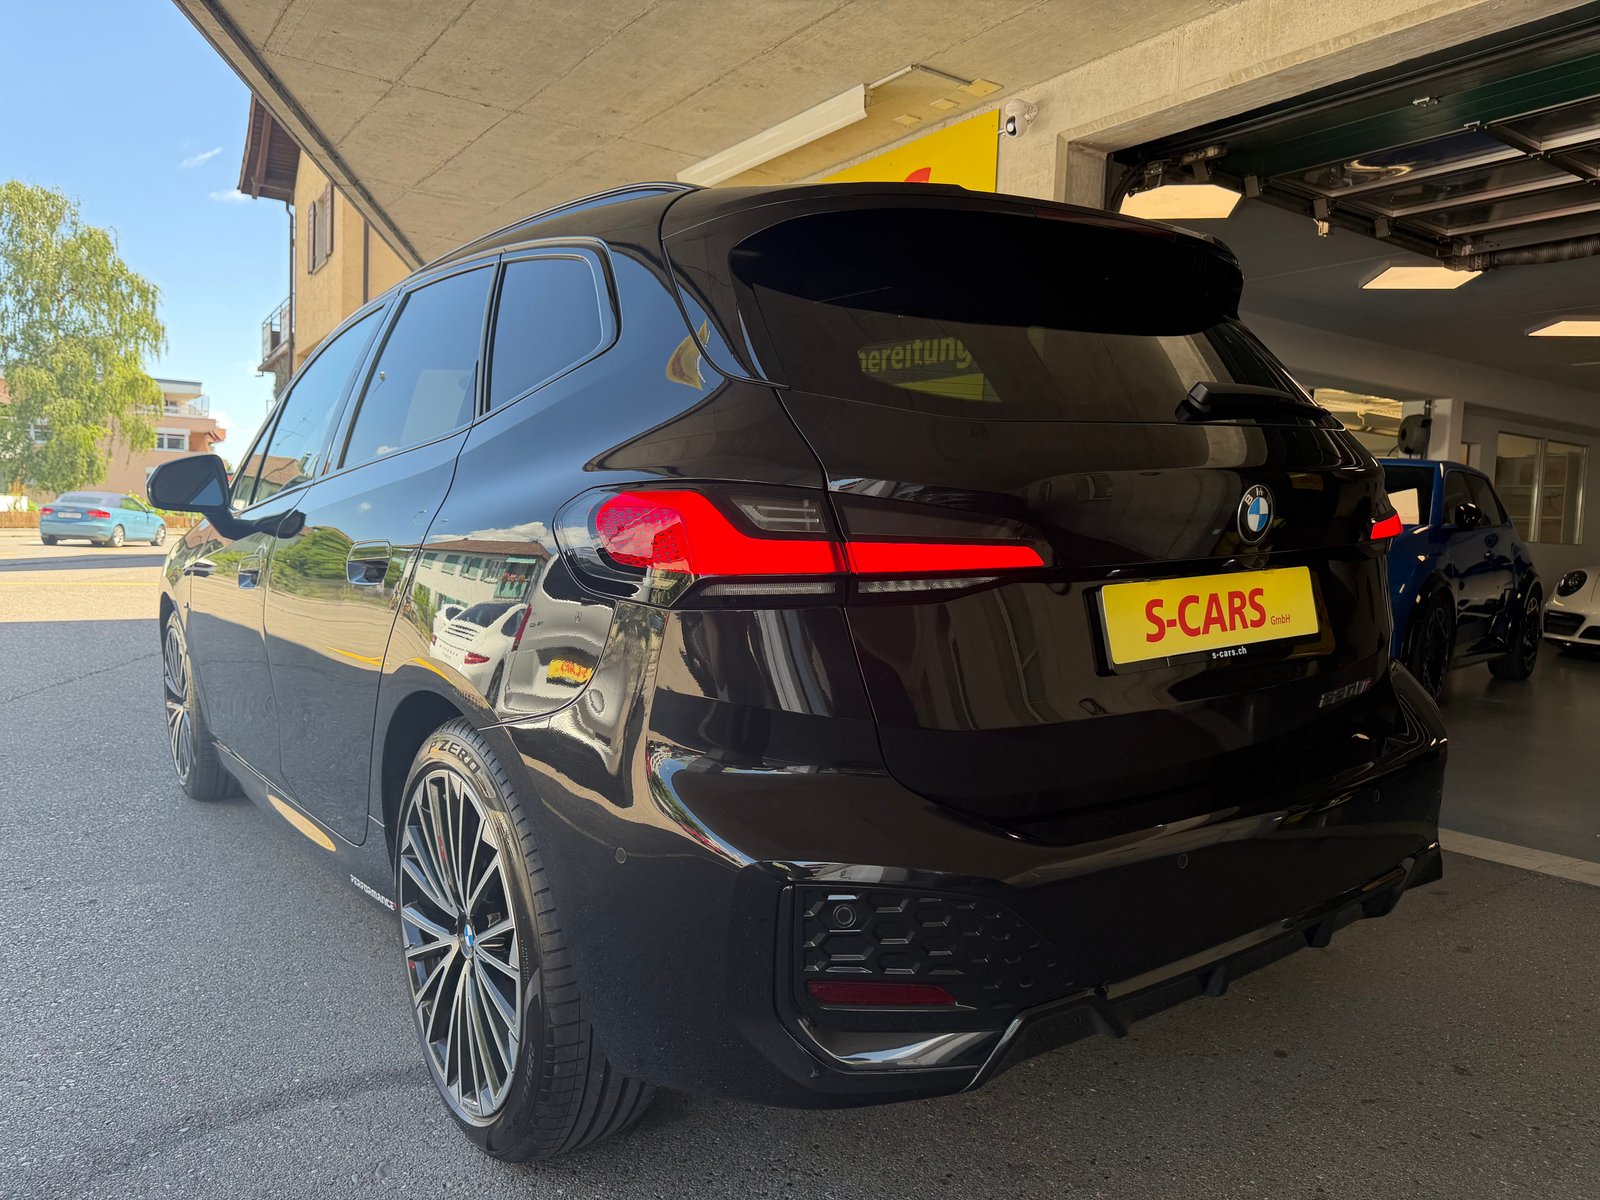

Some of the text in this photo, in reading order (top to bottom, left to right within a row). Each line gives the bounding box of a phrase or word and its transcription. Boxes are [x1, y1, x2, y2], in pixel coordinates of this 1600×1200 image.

[1145, 588, 1291, 642] S-CARS GmbH
[1212, 646, 1247, 659] s-cars.ch
[438, 739, 481, 774] ZERO
